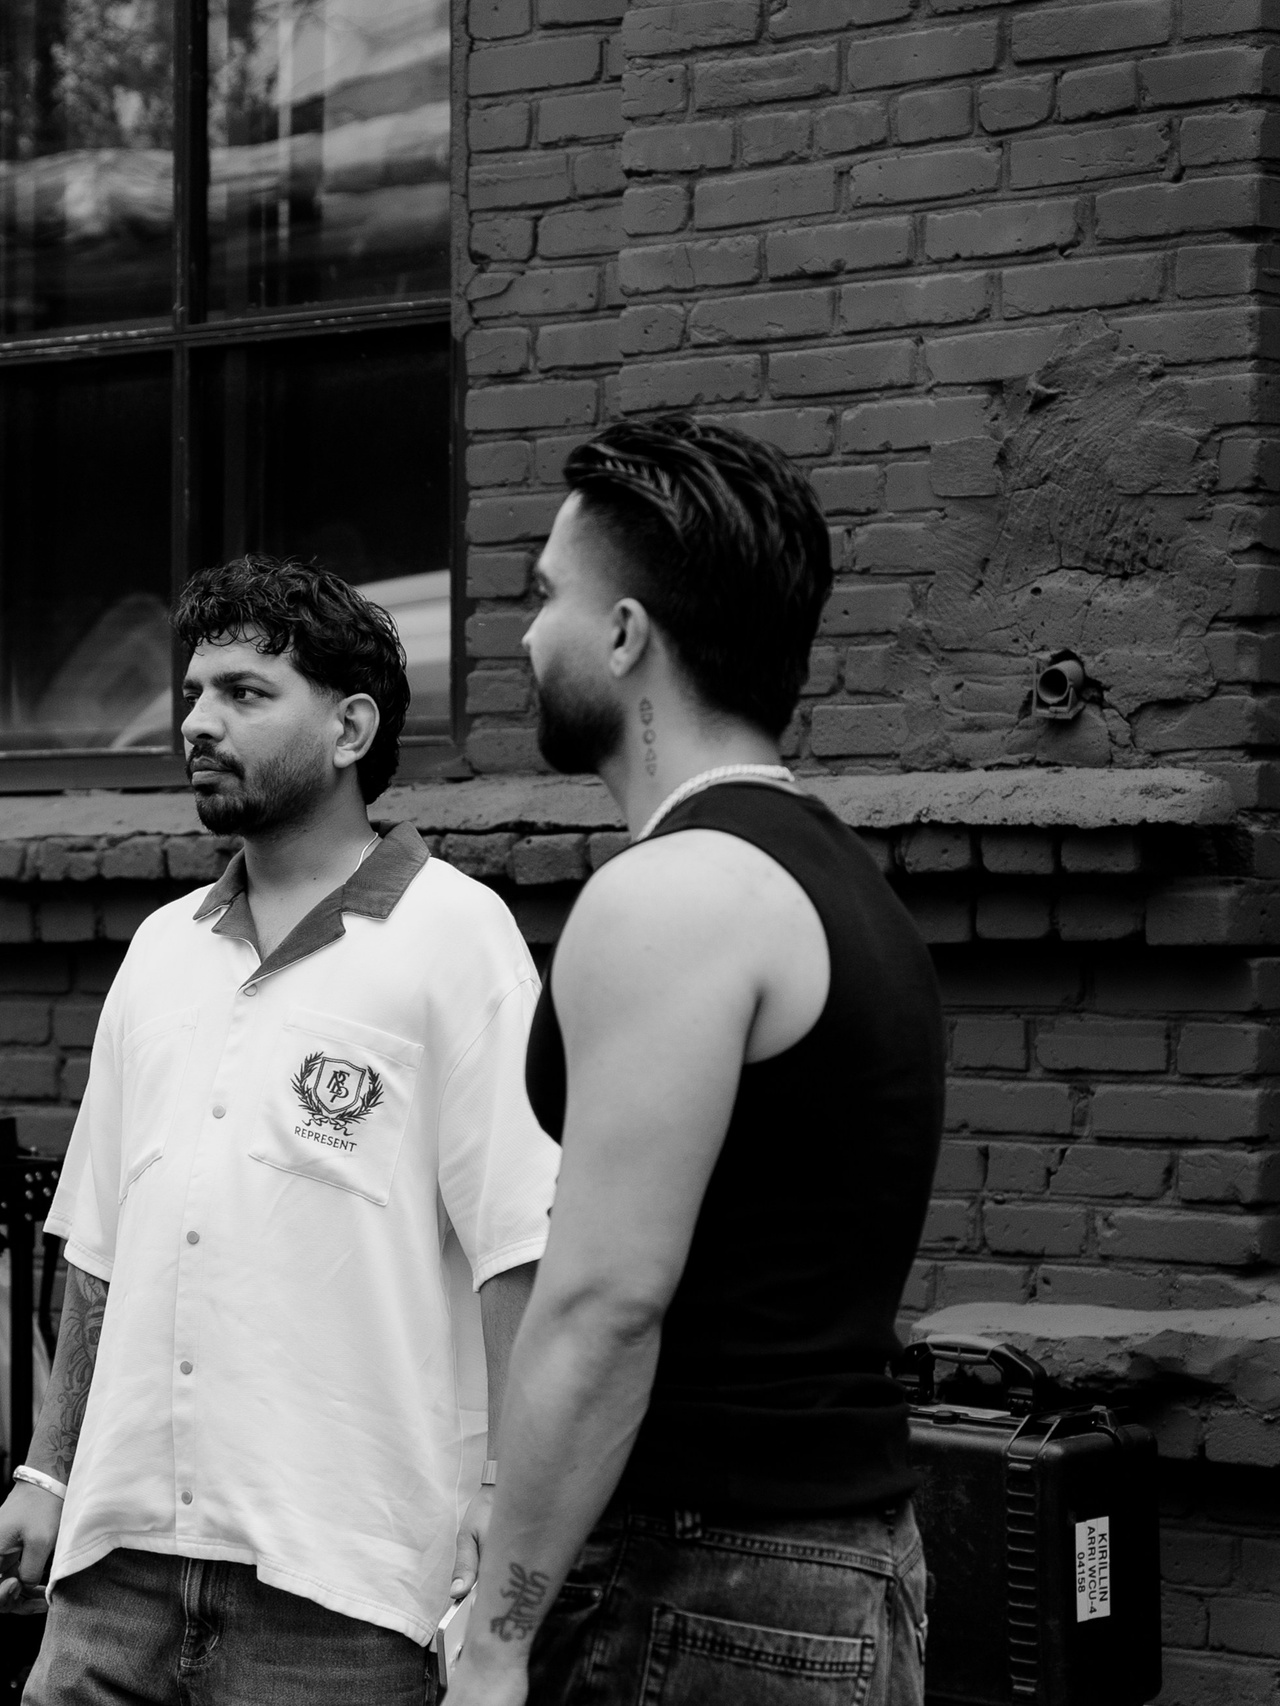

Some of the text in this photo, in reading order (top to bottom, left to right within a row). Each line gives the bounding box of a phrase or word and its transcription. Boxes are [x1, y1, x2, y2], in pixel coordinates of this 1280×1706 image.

[294, 1126, 357, 1152] REPRESENT
[1077, 1552, 1086, 1593] 04158
[1087, 1526, 1097, 1614] ARRI WCU-4
[1098, 1533, 1108, 1602] KIRILLIN
